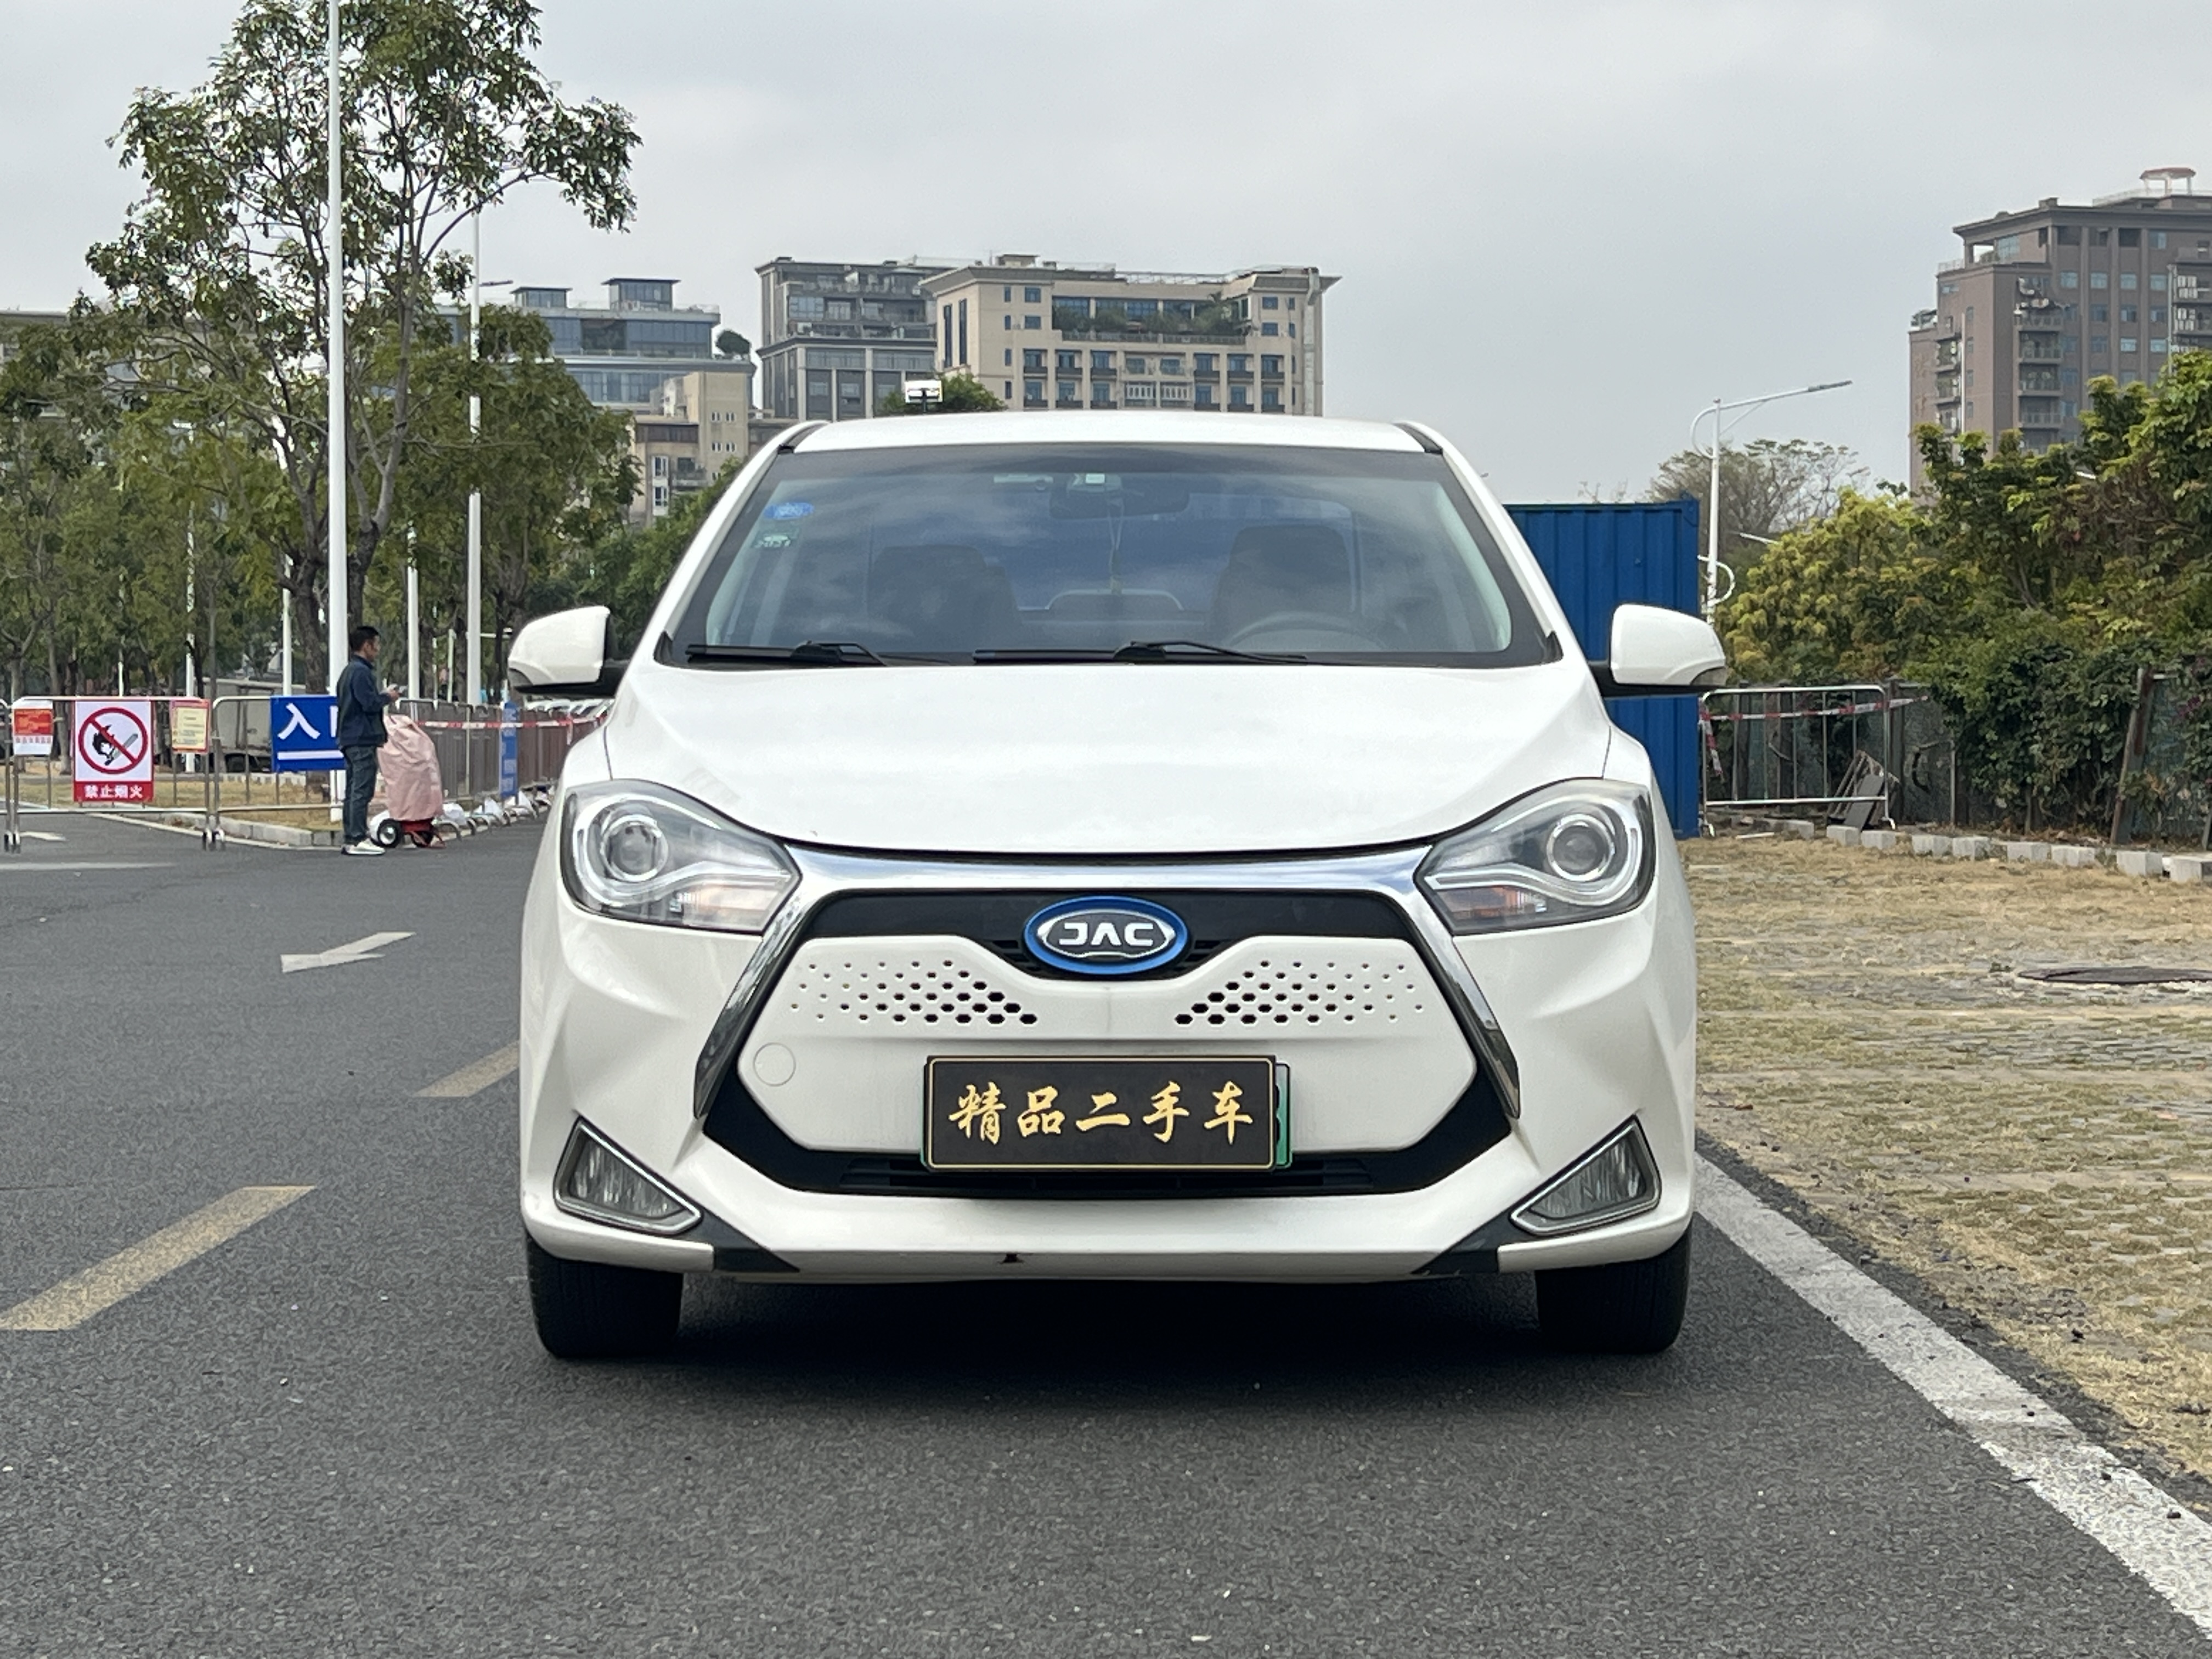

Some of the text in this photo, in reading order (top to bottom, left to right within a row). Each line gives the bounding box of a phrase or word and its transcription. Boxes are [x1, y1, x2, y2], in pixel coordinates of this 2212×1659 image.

[278, 703, 338, 740] 入
[84, 784, 143, 798] 禁止烟火
[1059, 923, 1154, 946] JAC
[949, 1081, 1253, 1145] 精品二手车
